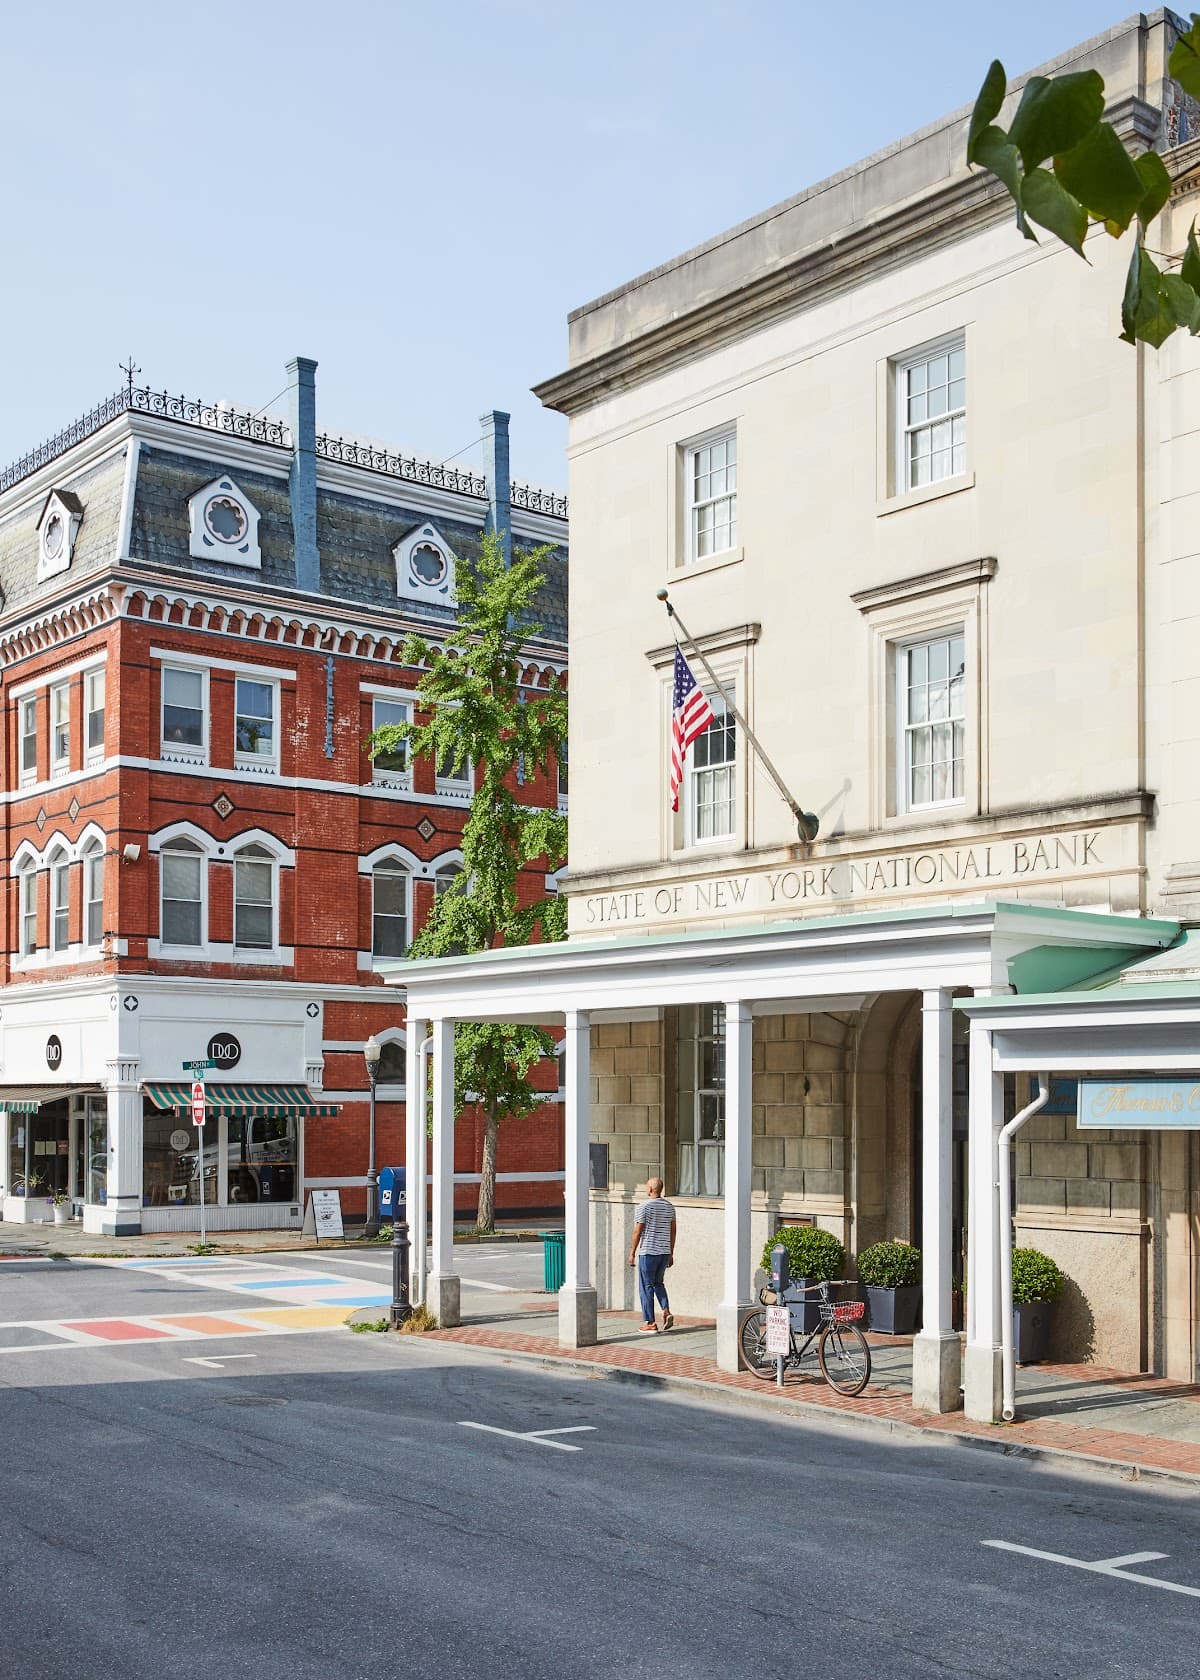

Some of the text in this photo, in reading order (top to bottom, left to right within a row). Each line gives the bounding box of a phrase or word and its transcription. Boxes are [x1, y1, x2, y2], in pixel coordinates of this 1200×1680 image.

[586, 831, 1105, 924] STATE OF NEW YORK NATIONAL BANK
[188, 1060, 207, 1069] JOHN
[1091, 1085, 1168, 1118] Theresa
[1169, 1091, 1184, 1112] &
